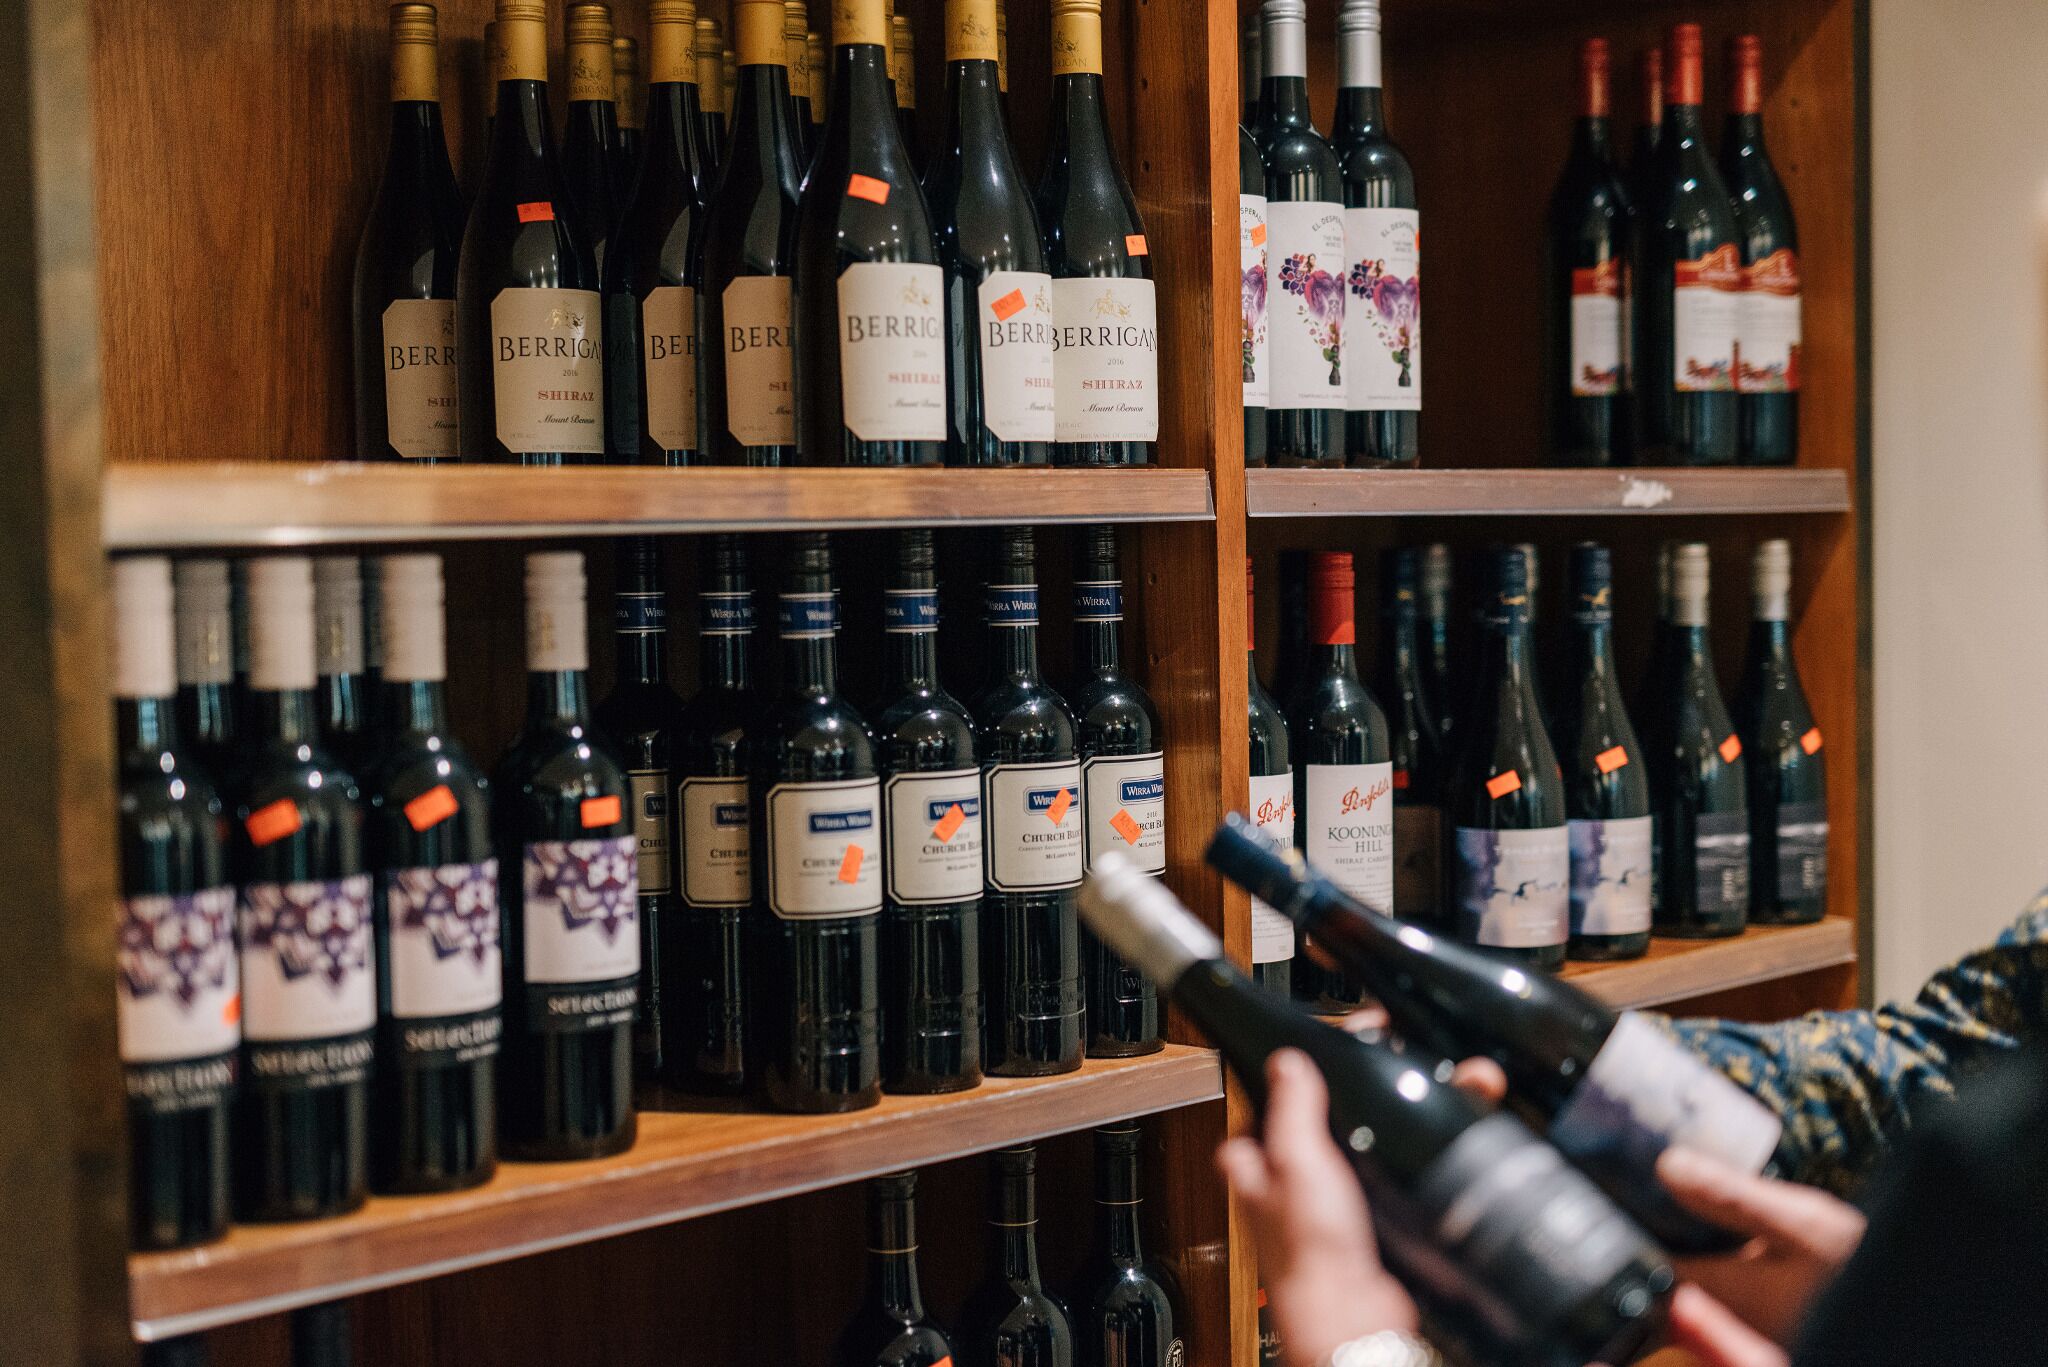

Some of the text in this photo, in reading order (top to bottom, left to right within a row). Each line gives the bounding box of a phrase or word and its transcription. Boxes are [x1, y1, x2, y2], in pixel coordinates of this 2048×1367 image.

[1082, 378, 1144, 390] SHIRAZ
[537, 390, 595, 402] SHIRAZ
[1082, 403, 1114, 413] Mount
[1082, 596, 1111, 607] WIRRA
[1126, 786, 1150, 797] WIRRA
[1341, 776, 1390, 816] Penfolds
[1022, 833, 1065, 844] CHURCH
[1354, 840, 1384, 854] HILL
